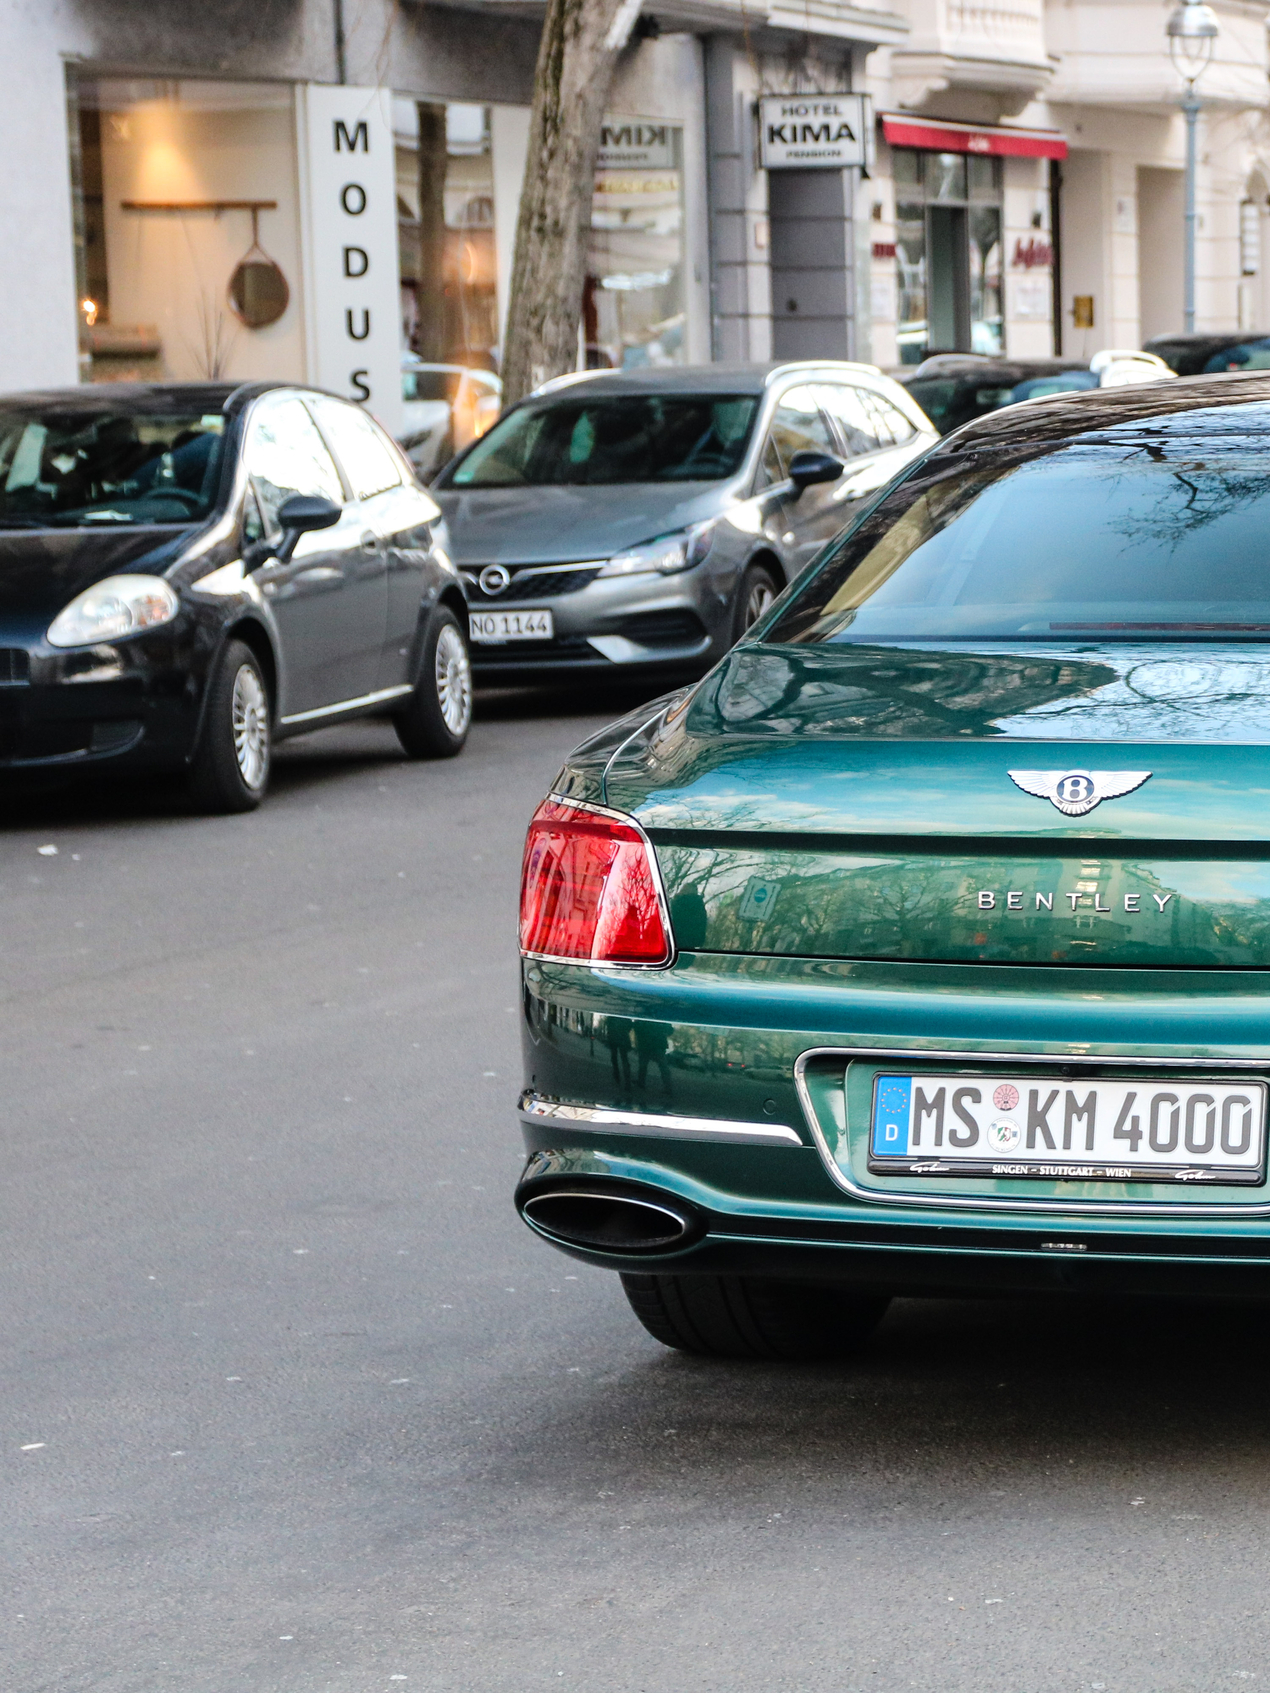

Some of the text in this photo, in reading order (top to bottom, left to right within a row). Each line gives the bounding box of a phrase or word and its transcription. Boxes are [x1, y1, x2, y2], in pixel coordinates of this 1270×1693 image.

[782, 104, 842, 116] HOTEL
[768, 123, 856, 142] KIMA
[334, 120, 370, 401] MODUS
[471, 615, 547, 635] NO 1144
[978, 891, 1172, 912] BENTLEY
[885, 1124, 898, 1141] D
[912, 1086, 982, 1148] MS
[1026, 1089, 1097, 1150] KM
[1113, 1092, 1252, 1154] 4000
[992, 1164, 1028, 1174] SINGEN
[1039, 1166, 1093, 1176] STUTTGART
[1105, 1168, 1132, 1178] WIEN
